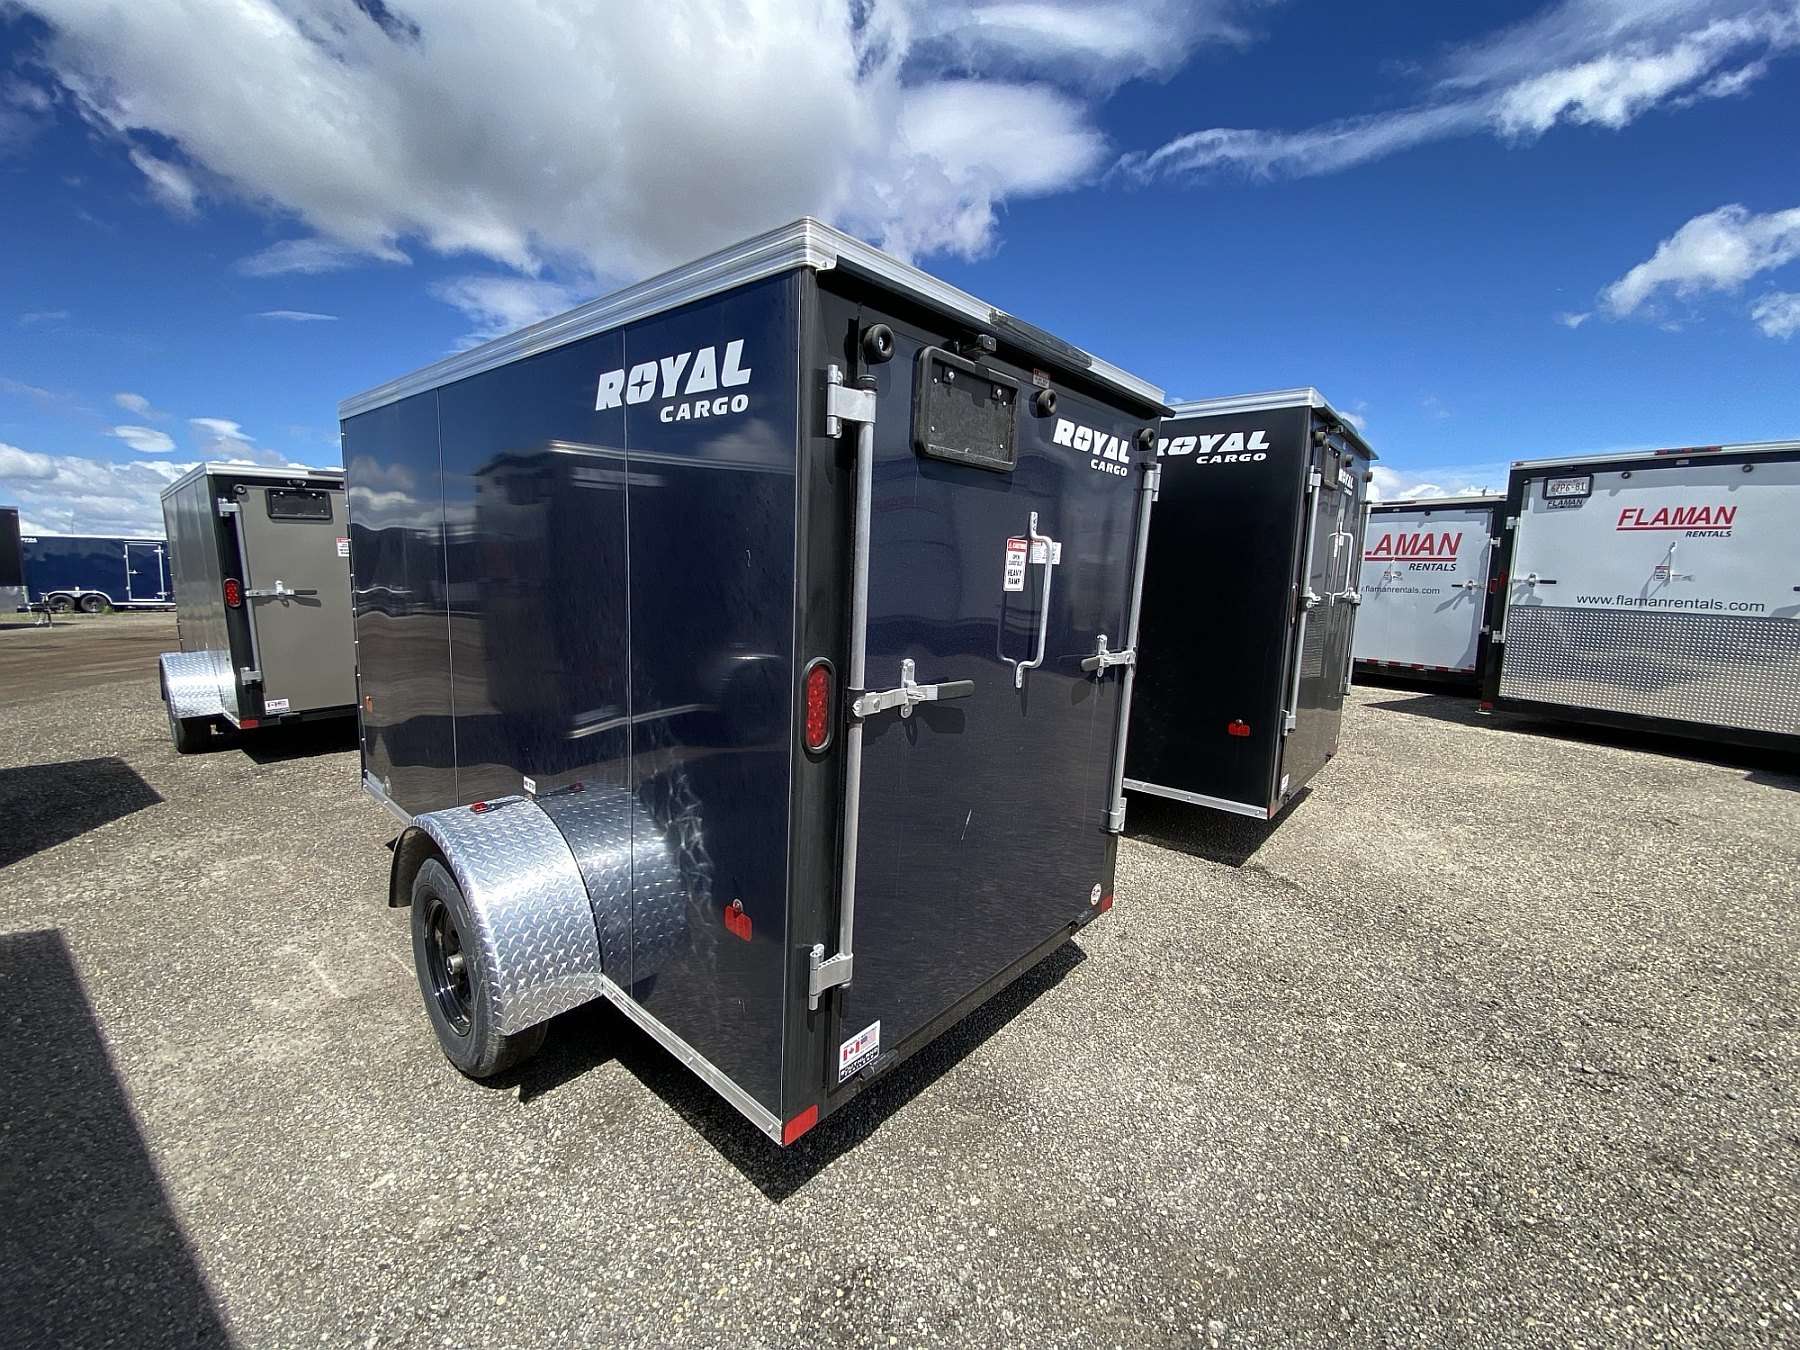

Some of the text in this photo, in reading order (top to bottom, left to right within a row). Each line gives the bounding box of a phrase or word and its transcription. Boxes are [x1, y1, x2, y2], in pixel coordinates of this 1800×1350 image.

[595, 339, 752, 411] ROYAL
[660, 394, 749, 423] CARGO
[1052, 418, 1130, 464] ROYAL
[1196, 452, 1267, 464] CARGO
[1090, 459, 1128, 477] CARGO
[1617, 506, 1738, 526] FLAMAN
[1685, 530, 1732, 538] RENTALS
[1007, 569, 1022, 577] HEAVY
[1409, 563, 1457, 572] RENTALS
[1007, 577, 1021, 585] RAMP
[1576, 595, 1765, 612] www.flamanrentals.com
